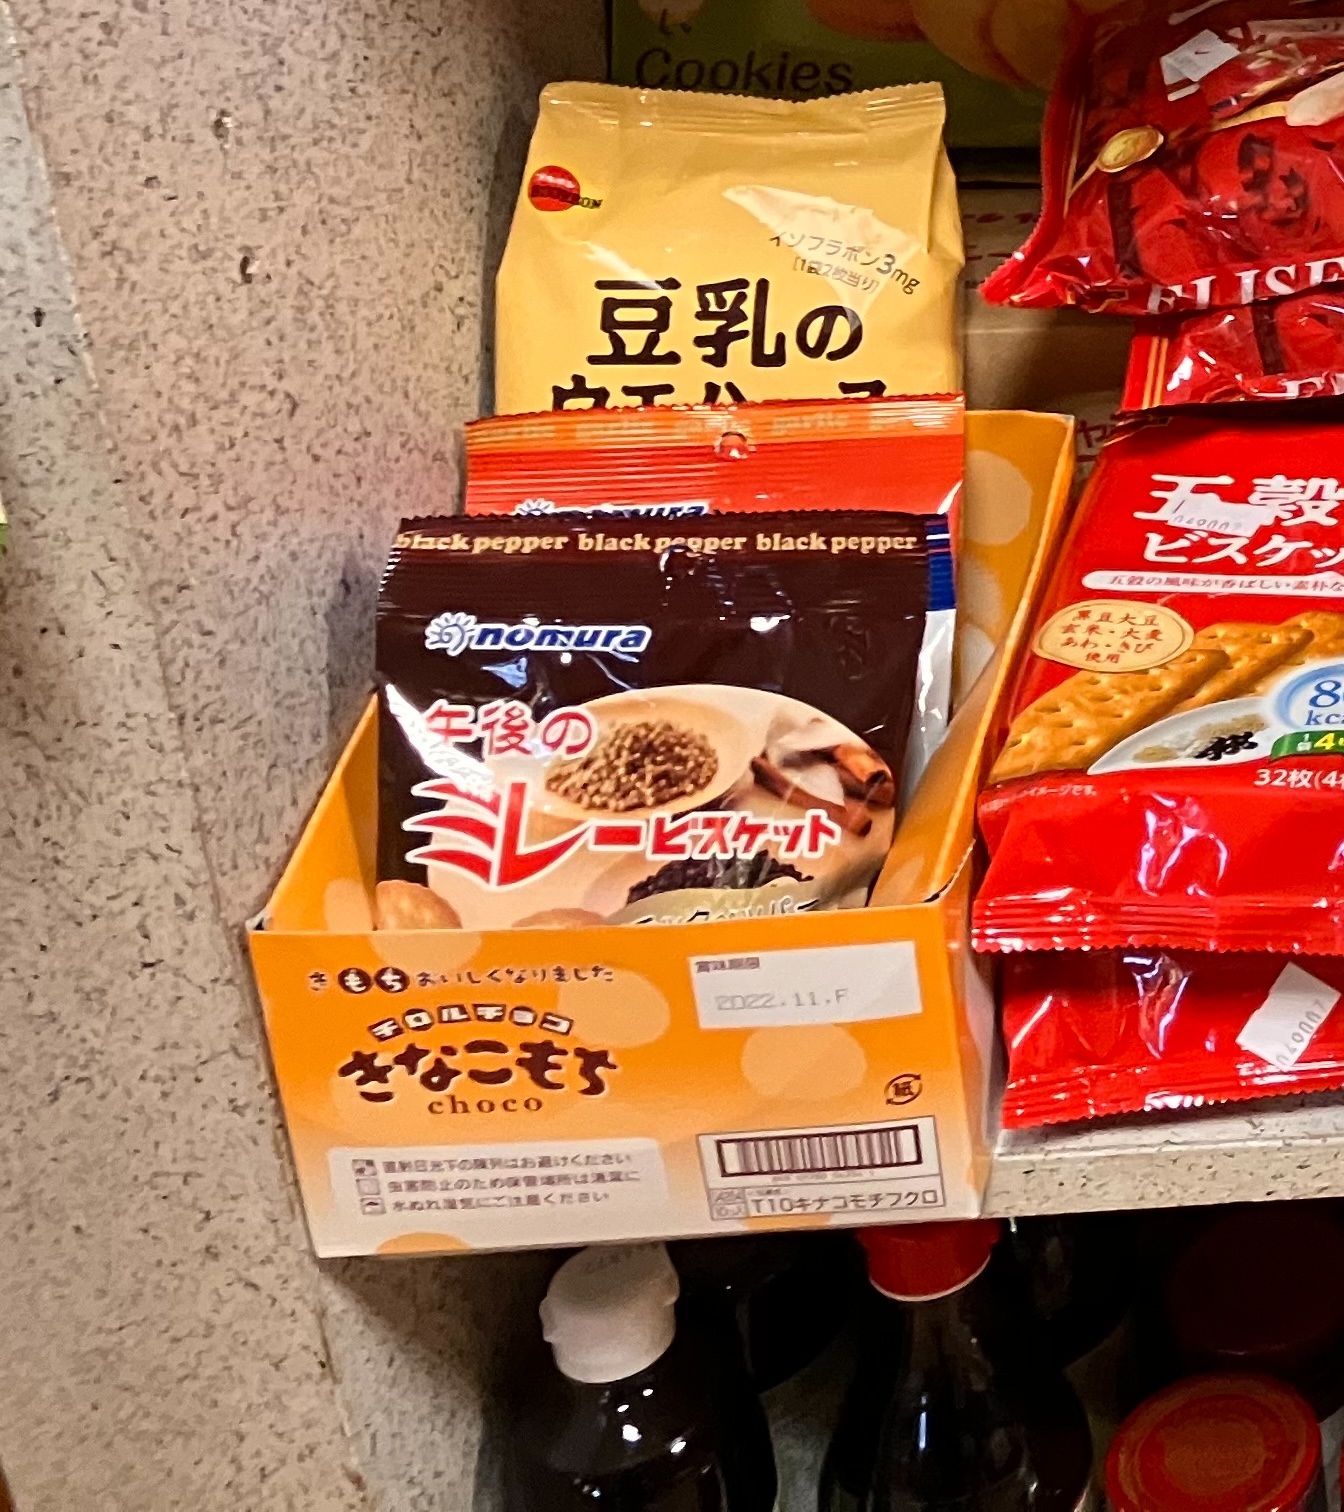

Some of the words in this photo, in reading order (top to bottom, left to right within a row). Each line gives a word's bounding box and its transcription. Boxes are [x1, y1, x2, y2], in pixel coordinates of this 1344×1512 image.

[635, 48, 854, 92] Cookies
[769, 230, 921, 294] イソフラボン3mg
[586, 276, 863, 369] 豆乳の
[396, 531, 469, 552] black
[472, 532, 568, 555] pepper
[578, 531, 650, 552] black
[756, 531, 828, 552] black
[830, 534, 918, 554] pepper
[474, 624, 649, 651] nomura
[424, 702, 594, 755] 午後の
[404, 781, 842, 887] ミレービスケット
[368, 1002, 575, 1042] チロルチョコ
[338, 1039, 619, 1103] きなこもち
[427, 1094, 544, 1115] choco
[750, 1188, 940, 1214] T10キナコモチフクロ
